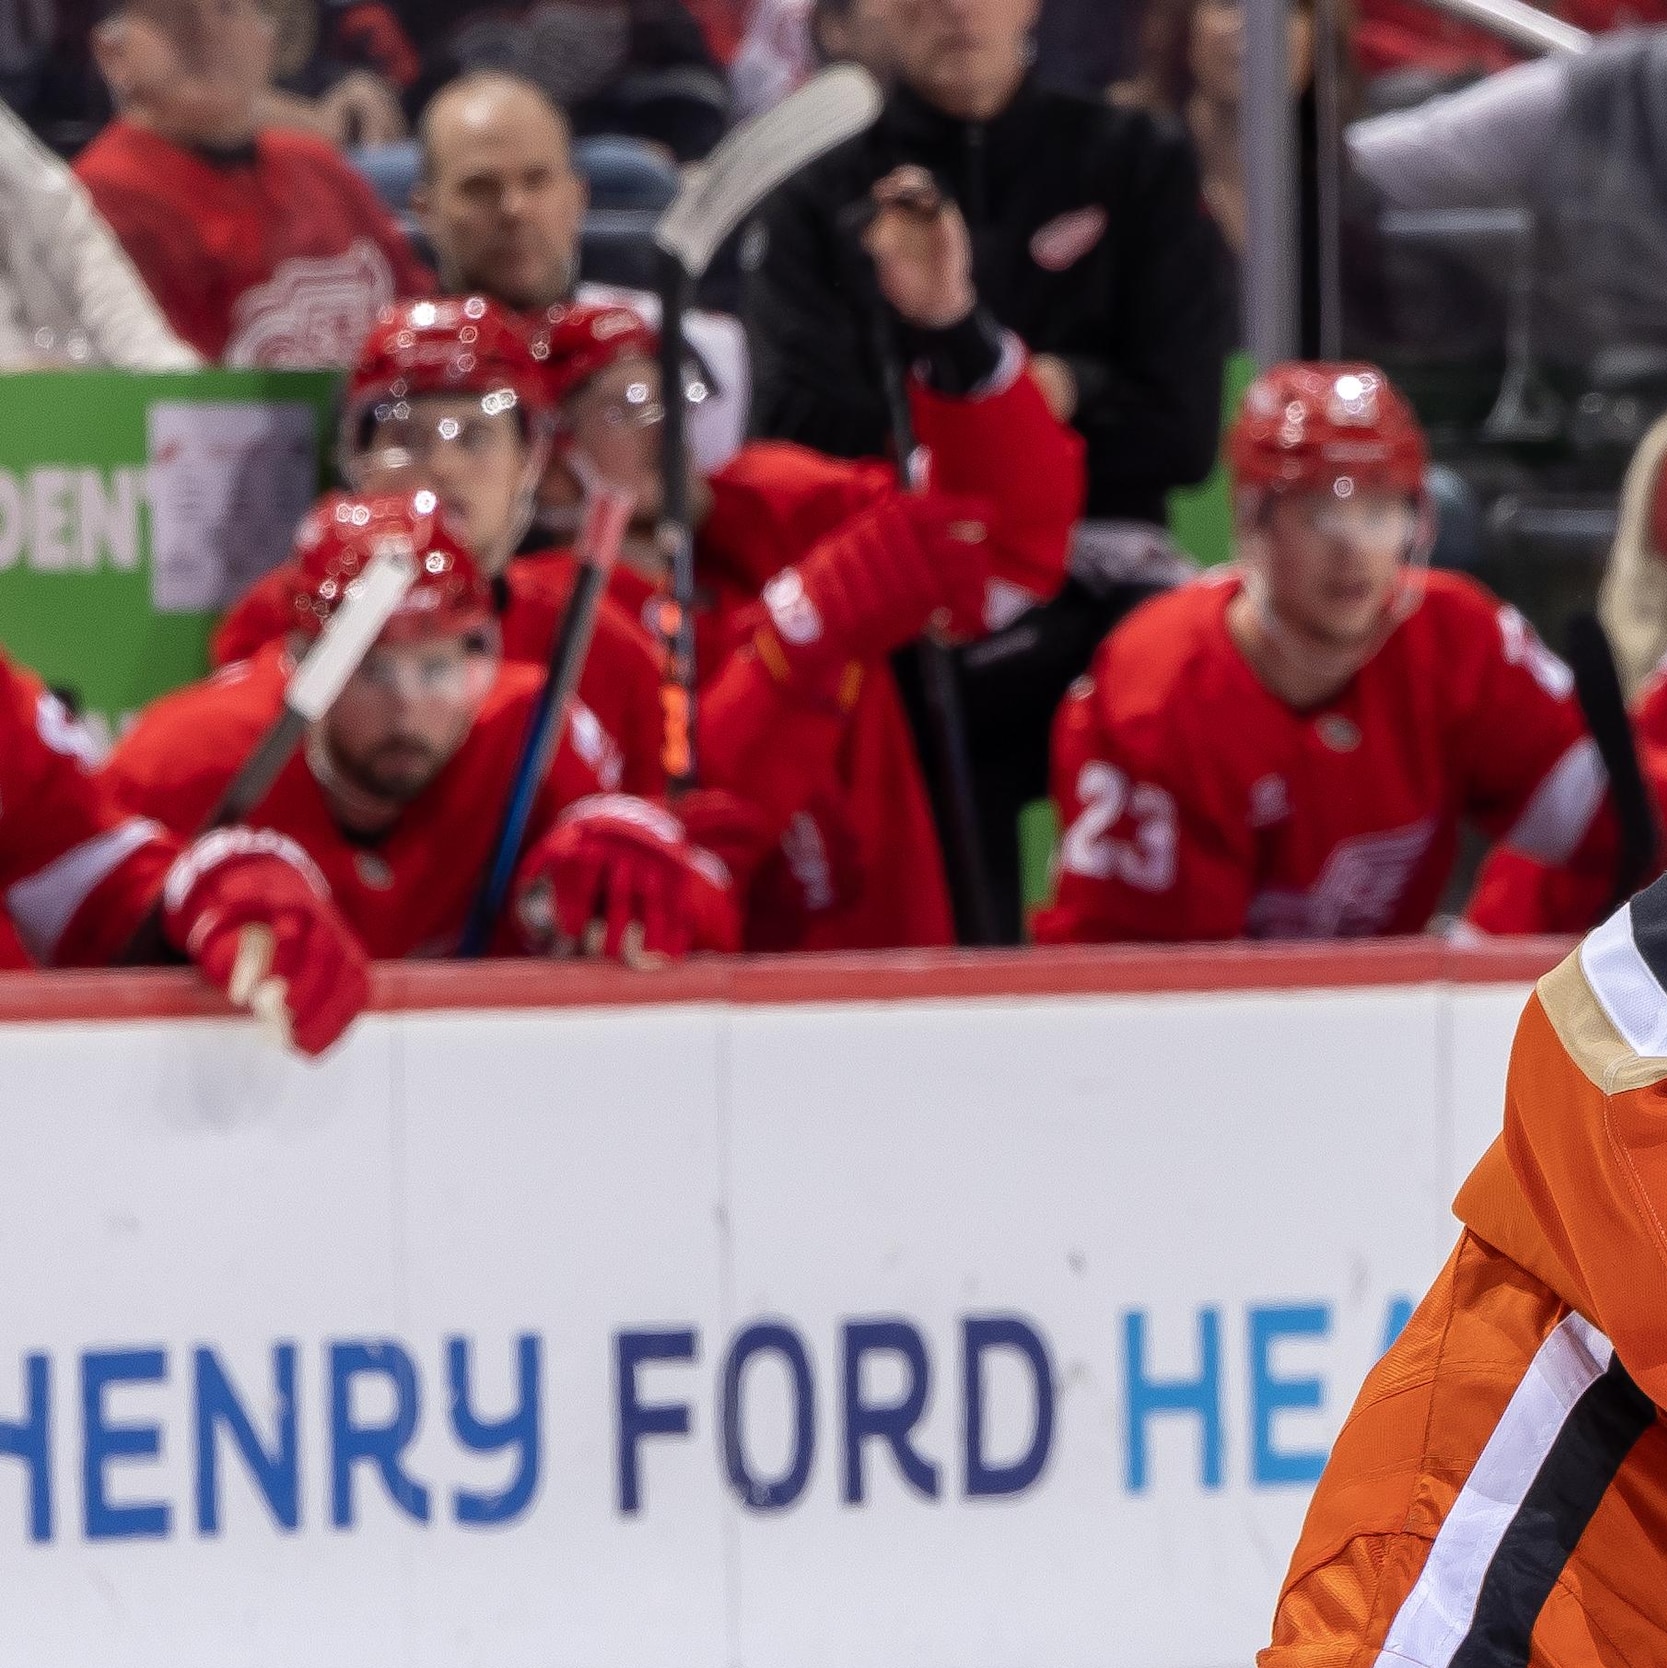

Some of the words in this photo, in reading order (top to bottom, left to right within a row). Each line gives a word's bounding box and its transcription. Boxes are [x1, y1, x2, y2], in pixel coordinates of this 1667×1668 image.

[1060, 759, 1178, 892] 23
[613, 1314, 1055, 1519] FORD
[1121, 1290, 1417, 1496] HE
